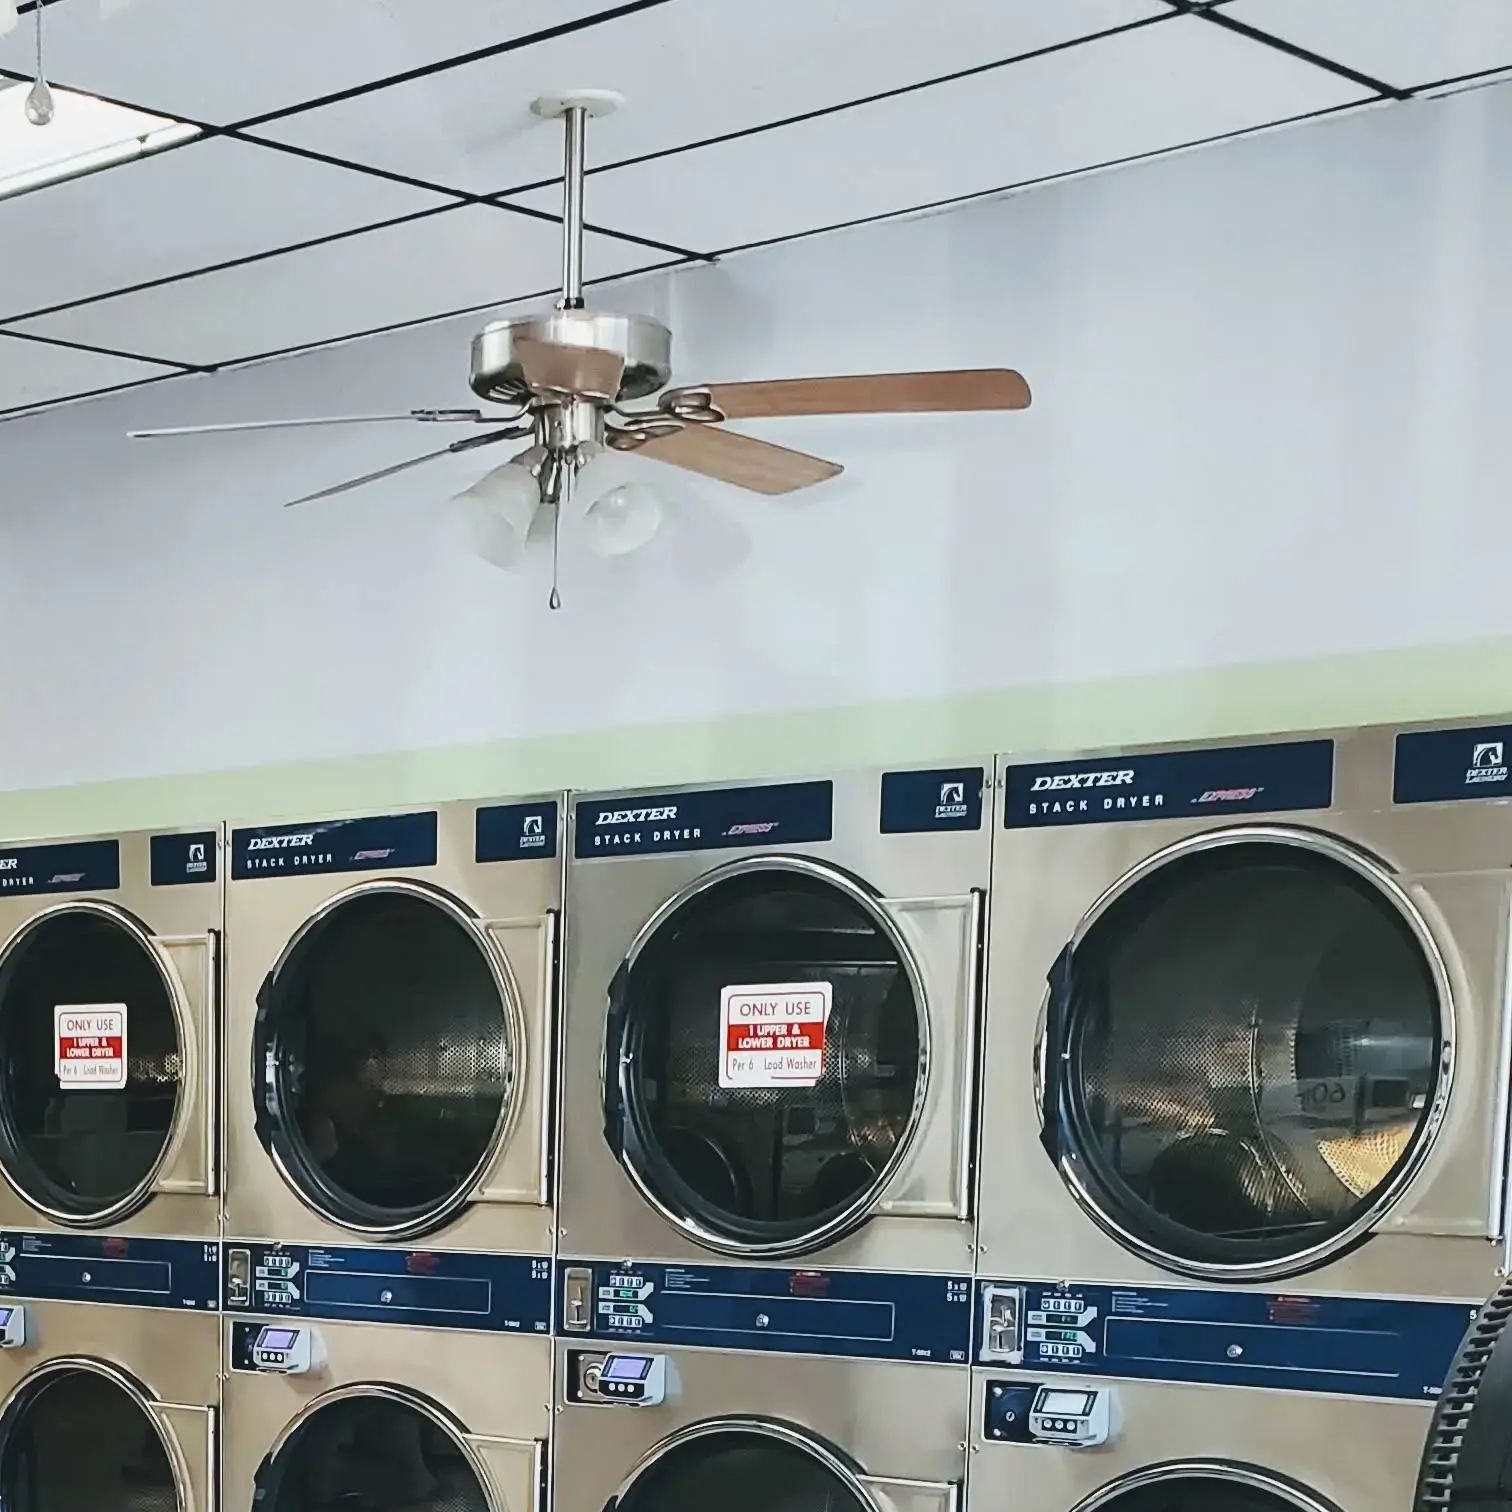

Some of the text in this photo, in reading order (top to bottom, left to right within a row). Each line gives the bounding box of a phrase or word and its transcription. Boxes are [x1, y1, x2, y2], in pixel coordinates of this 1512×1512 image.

[1030, 770, 1135, 791] DEXTER
[1029, 794, 1164, 814] STACK DRYER
[595, 806, 678, 825] DEXTER
[248, 834, 314, 850] DEXTER
[594, 828, 702, 846] STACK DRYER
[246, 853, 333, 870] STACK DRYER
[2, 876, 34, 888] DRYER
[740, 1001, 812, 1017] ONLY USE
[66, 1018, 114, 1031] ONLY USE
[749, 1023, 801, 1036] 1 UPPER &
[78, 1037, 99, 1047] UPPER
[738, 1035, 811, 1049] LOWER DRYER
[66, 1047, 114, 1058] LOWER DRYER
[83, 1063, 97, 1075] Load
[732, 1056, 817, 1072] Per 6 Load Washer
